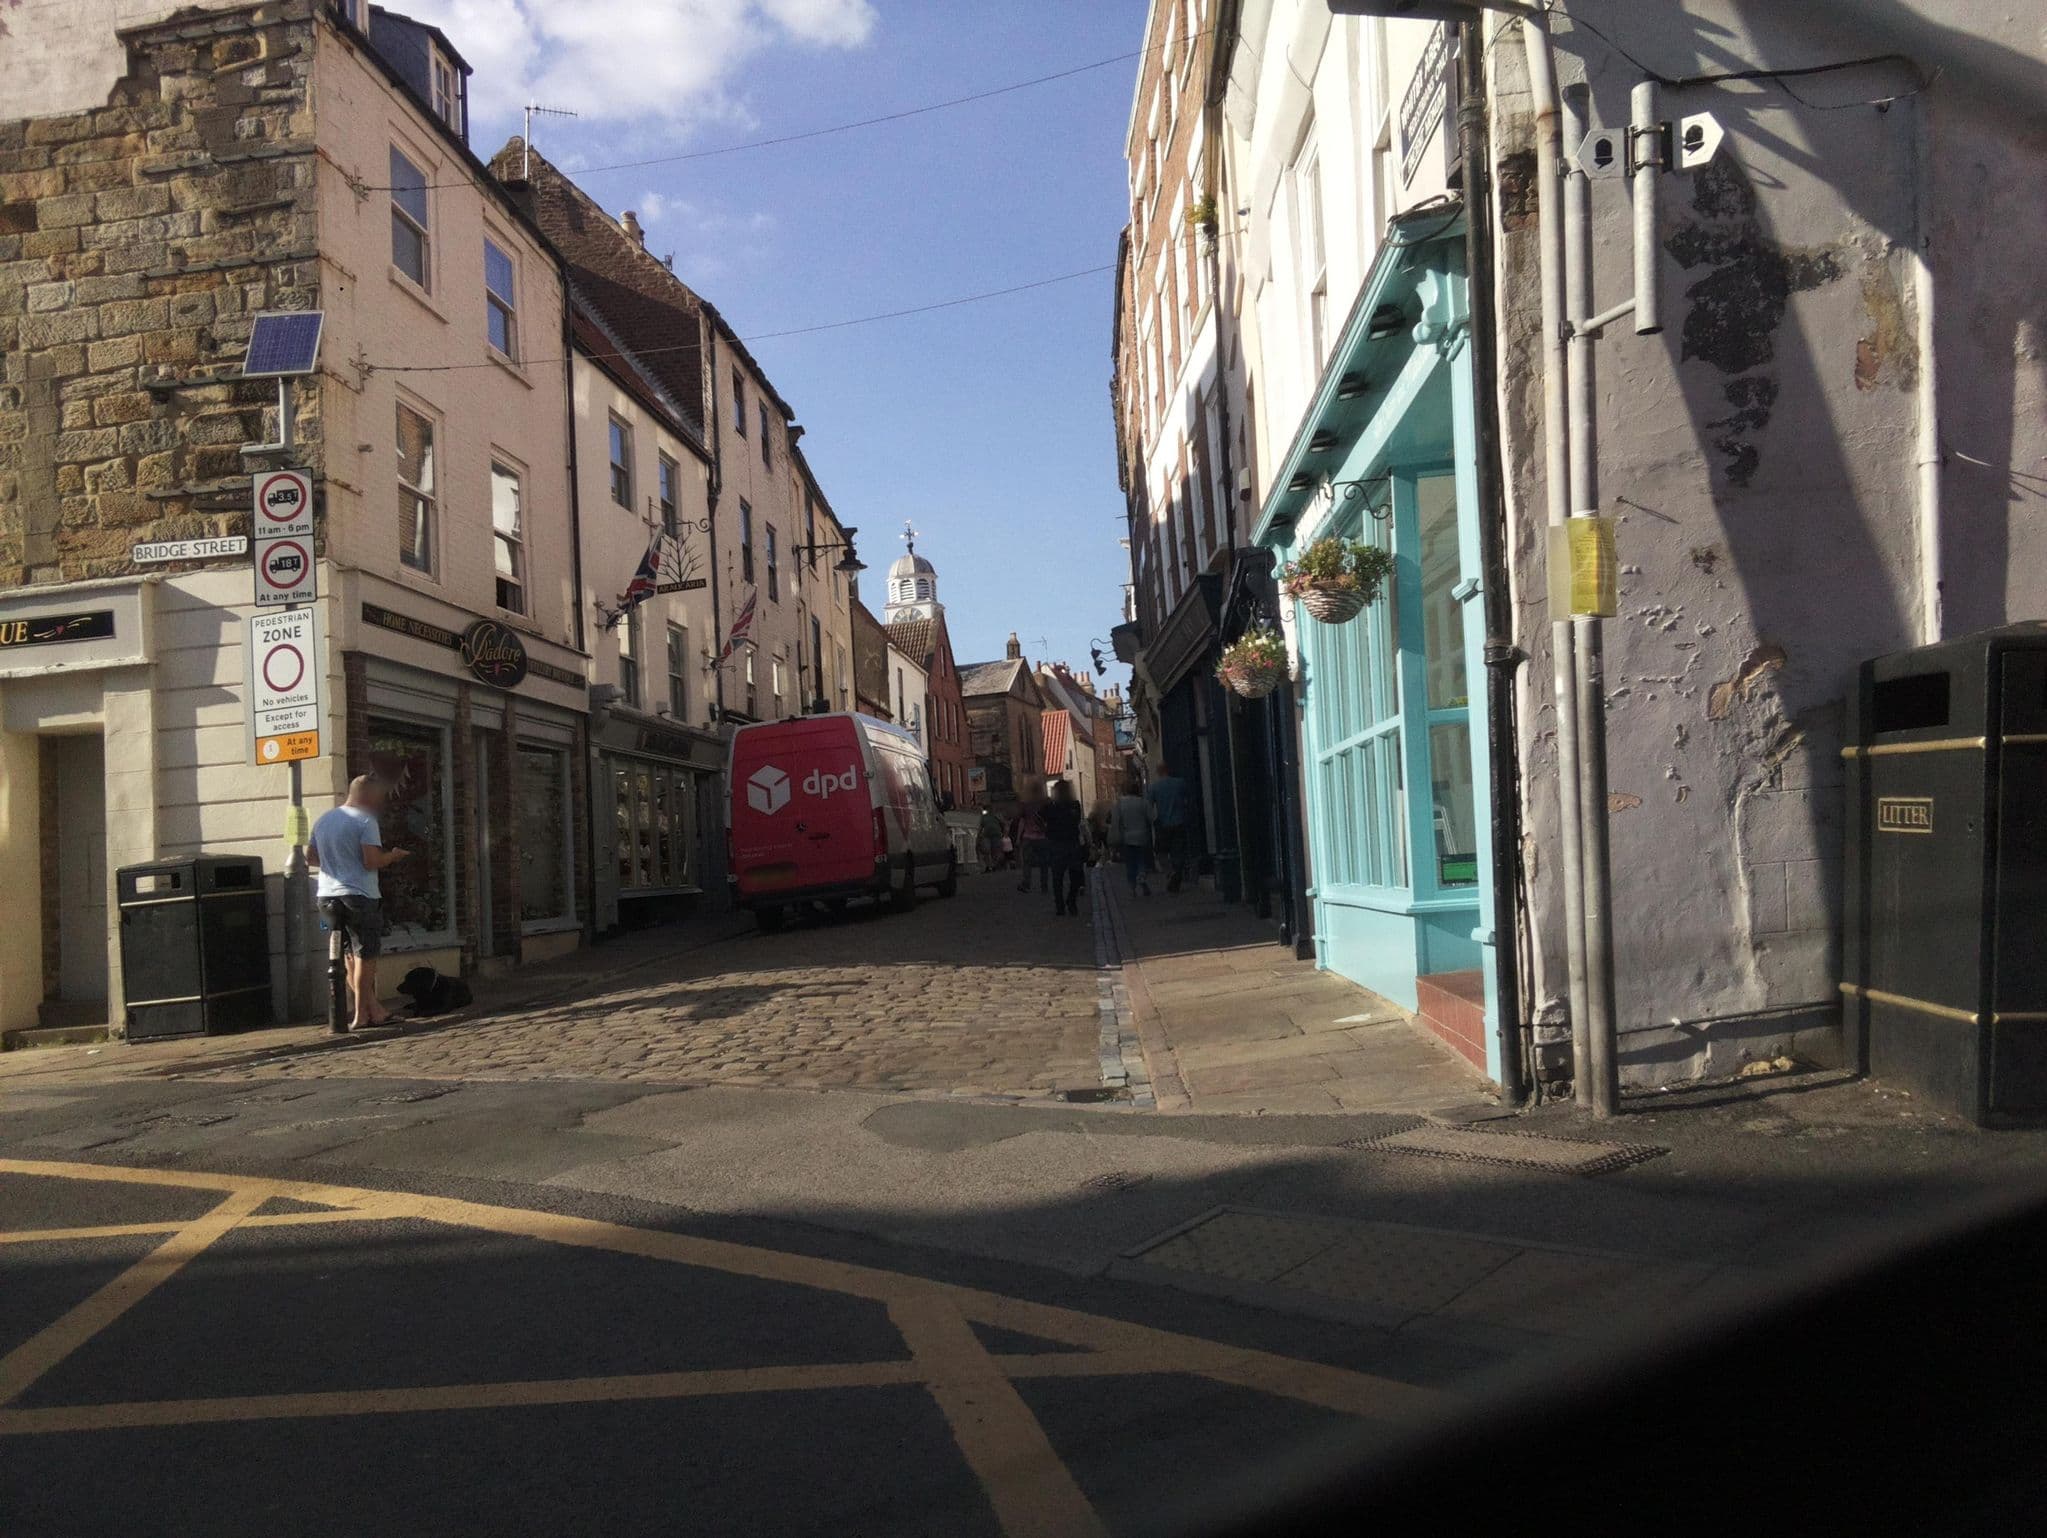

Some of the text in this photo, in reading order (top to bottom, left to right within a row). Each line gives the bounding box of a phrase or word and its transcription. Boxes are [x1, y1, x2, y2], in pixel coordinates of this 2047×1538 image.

[258, 526, 266, 535] 11
[288, 524, 294, 532] 6
[296, 523, 310, 533] pm
[135, 538, 246, 560] BRIDGE STREET
[260, 590, 312, 601] At any time
[255, 612, 310, 628] PEDESTRIAN
[382, 611, 407, 633] HOME
[263, 626, 302, 643] ZONE
[262, 694, 309, 707] No vehicles
[265, 710, 307, 723] Except for
[273, 722, 300, 731] access
[287, 736, 313, 746] At any
[291, 746, 309, 755] time
[802, 764, 857, 800] dpd
[1883, 805, 1929, 825] LITTER
